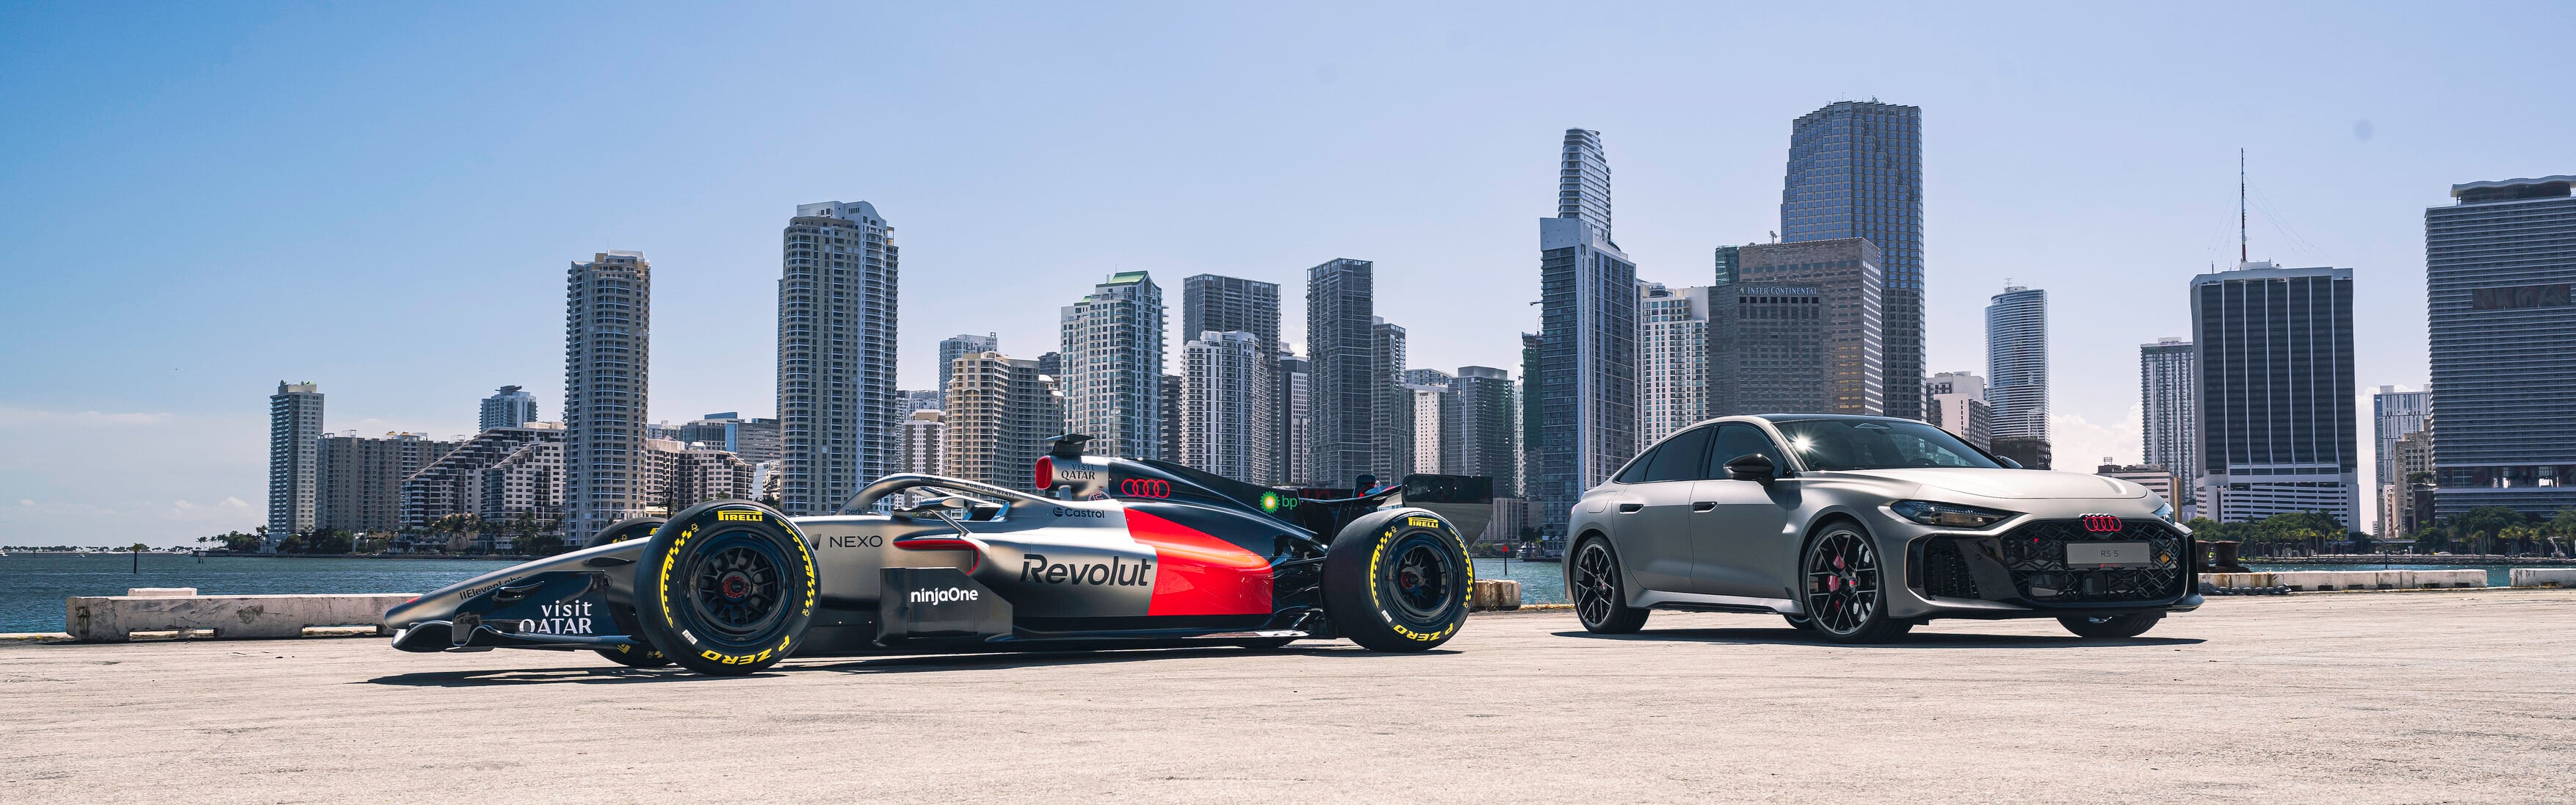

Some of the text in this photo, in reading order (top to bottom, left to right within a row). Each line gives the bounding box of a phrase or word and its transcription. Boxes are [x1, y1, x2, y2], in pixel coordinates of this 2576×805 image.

[1061, 470, 1095, 480] QATAR
[1071, 463, 1095, 472] visit
[1282, 495, 1298, 510] bp
[717, 510, 763, 521] PIRELLI
[1065, 508, 1105, 519] Castrol
[1408, 516, 1439, 529] PIRELLI
[830, 535, 883, 548] NEXO
[1019, 554, 1151, 587] Revolut
[911, 588, 979, 606] ninjaOne
[541, 599, 593, 617] visit
[518, 618, 593, 635] QATAR
[1393, 622, 1453, 641] P ZERO
[701, 635, 790, 665] P ZERO
